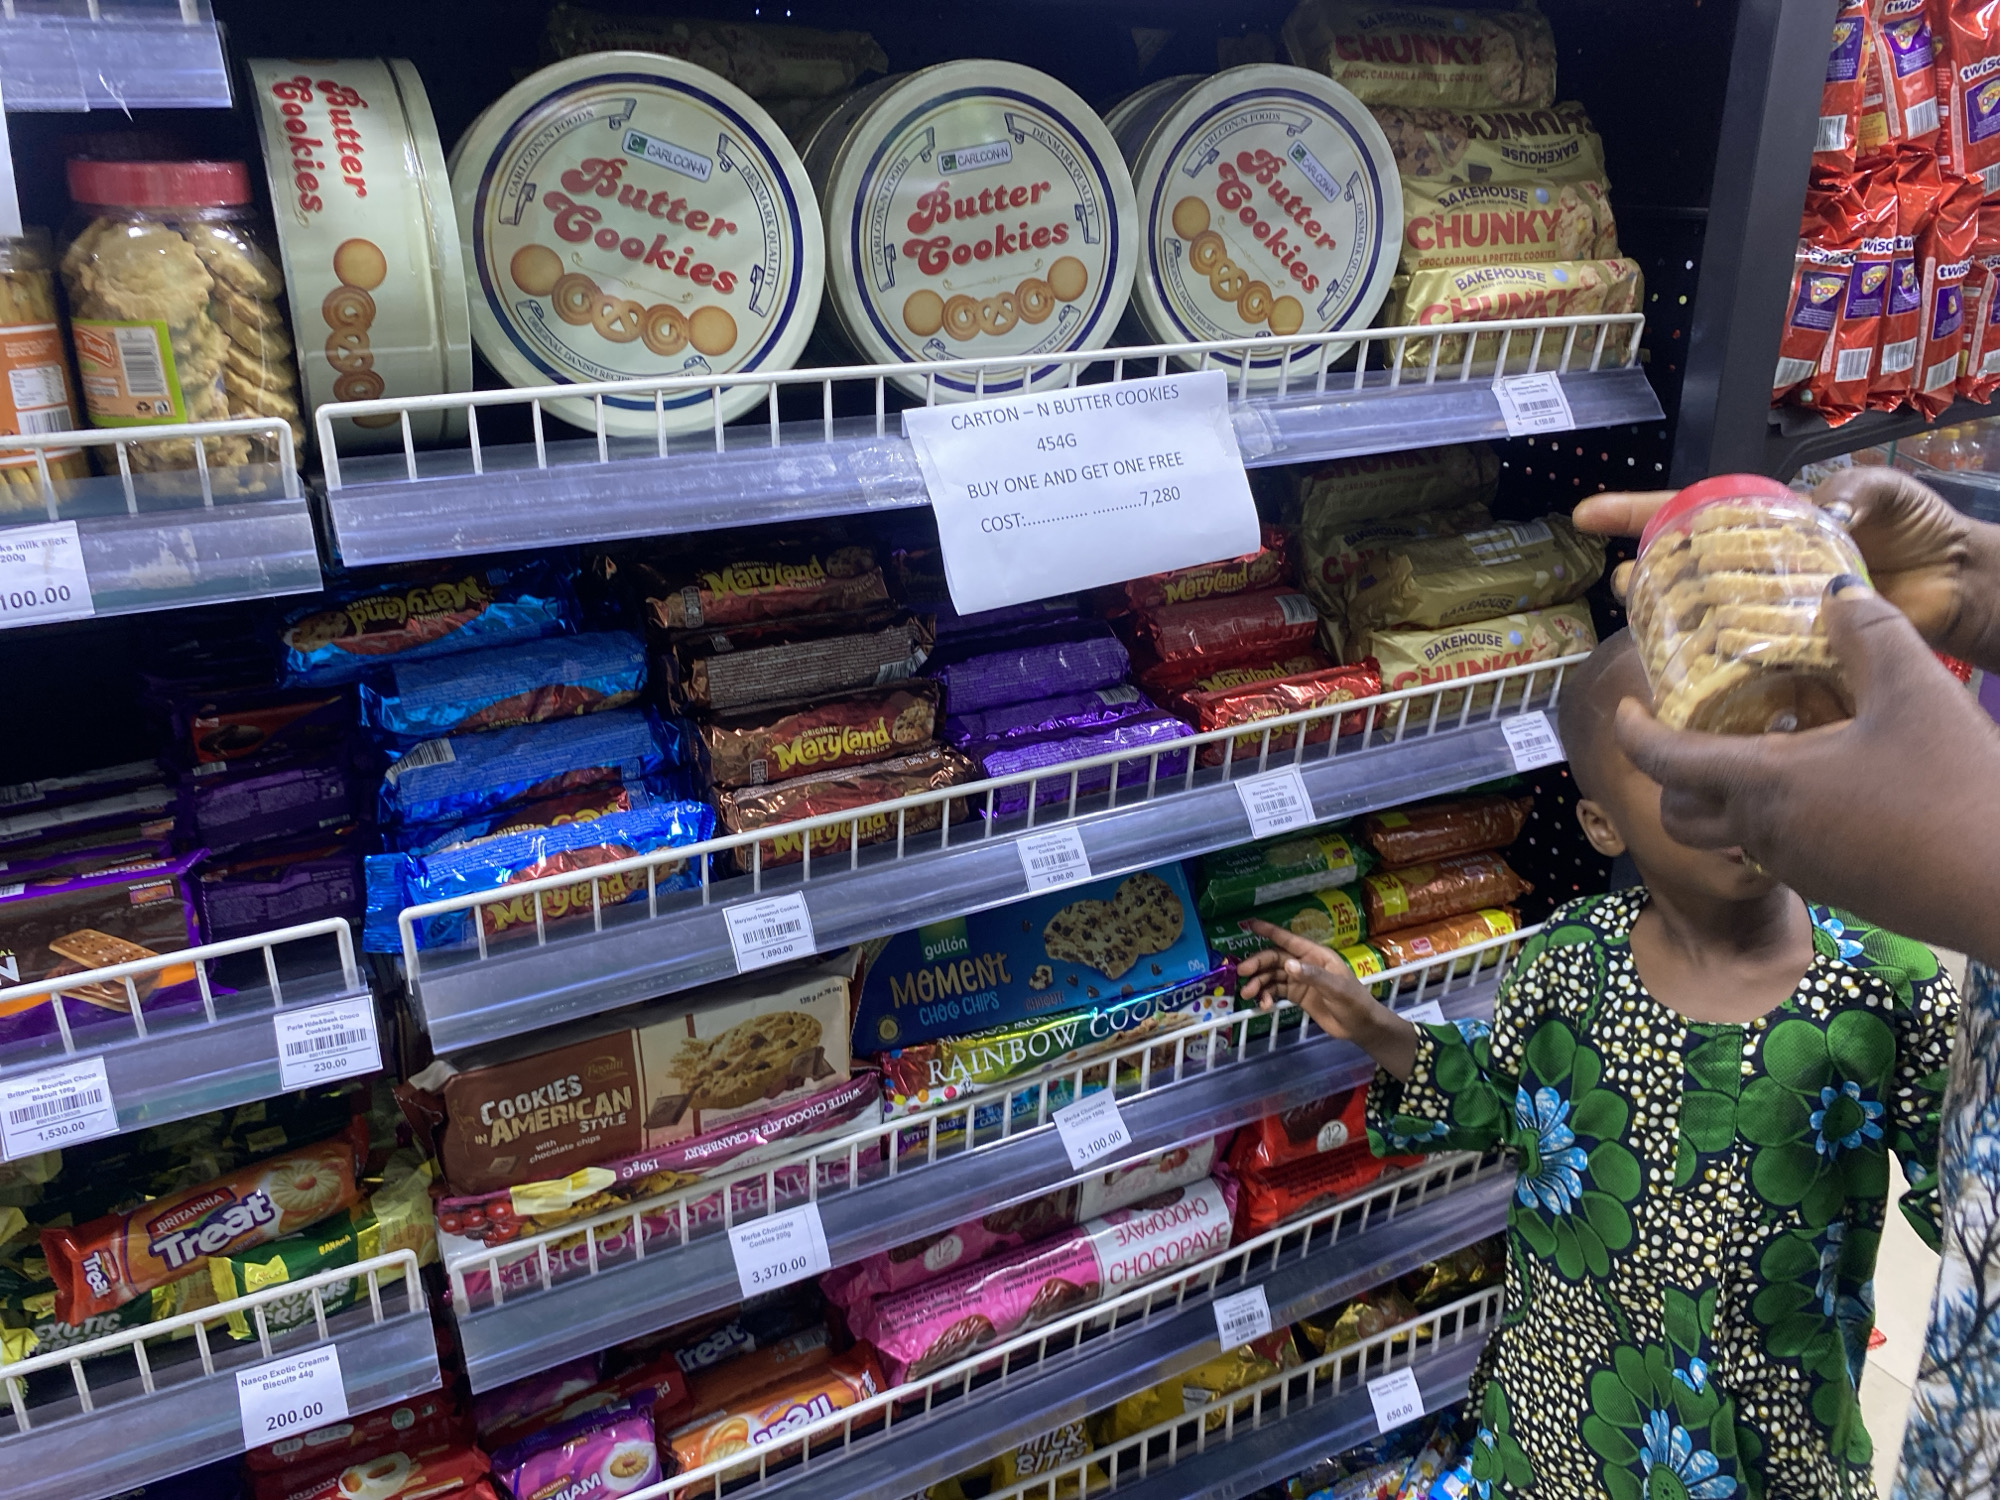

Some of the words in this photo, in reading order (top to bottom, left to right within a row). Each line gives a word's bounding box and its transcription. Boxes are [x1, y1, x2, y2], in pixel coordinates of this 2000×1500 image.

[1335, 35, 1484, 66] CHUNKY
[271, 74, 323, 213] Cookies
[316, 79, 368, 199] Butter
[1500, 140, 1579, 165] BAKEHOUSE
[1032, 127, 1074, 173] DENMARK
[1071, 163, 1095, 218] QUALITY
[560, 157, 738, 238] Butter
[907, 180, 1051, 235] Butter
[1236, 148, 1337, 252] Butter
[1438, 186, 1529, 208] BAKEHOUSE
[543, 189, 739, 294] Cookies
[742, 164, 777, 230] DENMARK
[764, 230, 778, 290] QUALITY
[1216, 162, 1320, 294] Cookies
[1406, 208, 1564, 250] CHUNKY
[902, 221, 1070, 276] Cookies
[1444, 255, 1479, 266] CARAMEL
[1522, 251, 1556, 262] COOKIES
[1455, 268, 1546, 291] BAKEHOUSE
[1418, 288, 1581, 326] CHUNKY
[952, 406, 1019, 431] CARTON
[1037, 403, 1050, 418] N
[1054, 394, 1112, 415] BUTTER
[1116, 384, 1179, 408] COOKIES
[1037, 433, 1077, 452] 454G
[967, 482, 998, 499] BUY
[1004, 474, 1039, 493] ONE
[1044, 468, 1077, 487] AND
[1081, 463, 1109, 481] GET
[1114, 457, 1145, 476] ONE
[1149, 452, 1183, 469] FREE
[0, 554, 26, 563] 200g
[16, 540, 39, 550] milk
[702, 554, 825, 600] Maryland
[1163, 562, 1249, 605] Maryland
[344, 575, 489, 638] Maryland
[1424, 632, 1503, 661] BAKEHOUSE
[772, 717, 890, 772] Maryland
[802, 726, 838, 738] ORIGINAL
[854, 744, 892, 757] cookies
[1028, 843, 1047, 851] Maryland
[735, 916, 757, 925] Maryland
[1338, 923, 1357, 935] EXTRA
[761, 944, 793, 959] 1,890.00
[924, 936, 969, 961] gullón
[963, 991, 1000, 1015] CHIPS
[305, 1017, 337, 1028] Hide&Seek
[306, 1026, 331, 1035] Cookies
[928, 1022, 1078, 1085] RAINBOW
[1089, 981, 1206, 1038] COOKIES
[314, 1058, 347, 1072] 230.00
[7, 1087, 40, 1099] Britannia
[42, 1079, 72, 1090] Bourbon
[74, 1073, 96, 1082] Choco
[32, 1091, 58, 1101] Biscuit
[480, 1074, 583, 1126] COOKIES
[827, 1087, 861, 1108] WHITE
[38, 1121, 85, 1141] 1,530.00
[474, 1134, 488, 1144] IN
[491, 1086, 632, 1147] AMERICAN
[579, 1112, 626, 1134] STYLE
[760, 1100, 828, 1137] CHOCOLATE
[529, 1143, 574, 1164] chocolate
[576, 1135, 600, 1147] chips
[536, 1139, 556, 1151] with
[684, 1132, 749, 1161] CRANBERRY
[1078, 1130, 1122, 1159] 3,100.00
[157, 1194, 224, 1230] BRITANNIA
[1116, 1198, 1210, 1247] CHOCOPAYE
[153, 1195, 273, 1268] Treat
[318, 1235, 351, 1255] BANANA
[741, 1231, 761, 1242] Merba
[762, 1221, 794, 1235] Chocolate
[749, 1236, 775, 1248] Cookies
[1109, 1222, 1229, 1286] CHOCOPAYE
[82, 1251, 111, 1298] Treat
[752, 1256, 806, 1283] 3,370.00
[241, 1374, 268, 1387] Nasco
[270, 1365, 296, 1378] Exotic
[298, 1355, 330, 1369] Creams
[263, 1376, 297, 1390] Biscuits
[299, 1370, 313, 1378] 44g
[266, 1402, 323, 1431] 200.00
[1016, 1443, 1087, 1477] BITES
